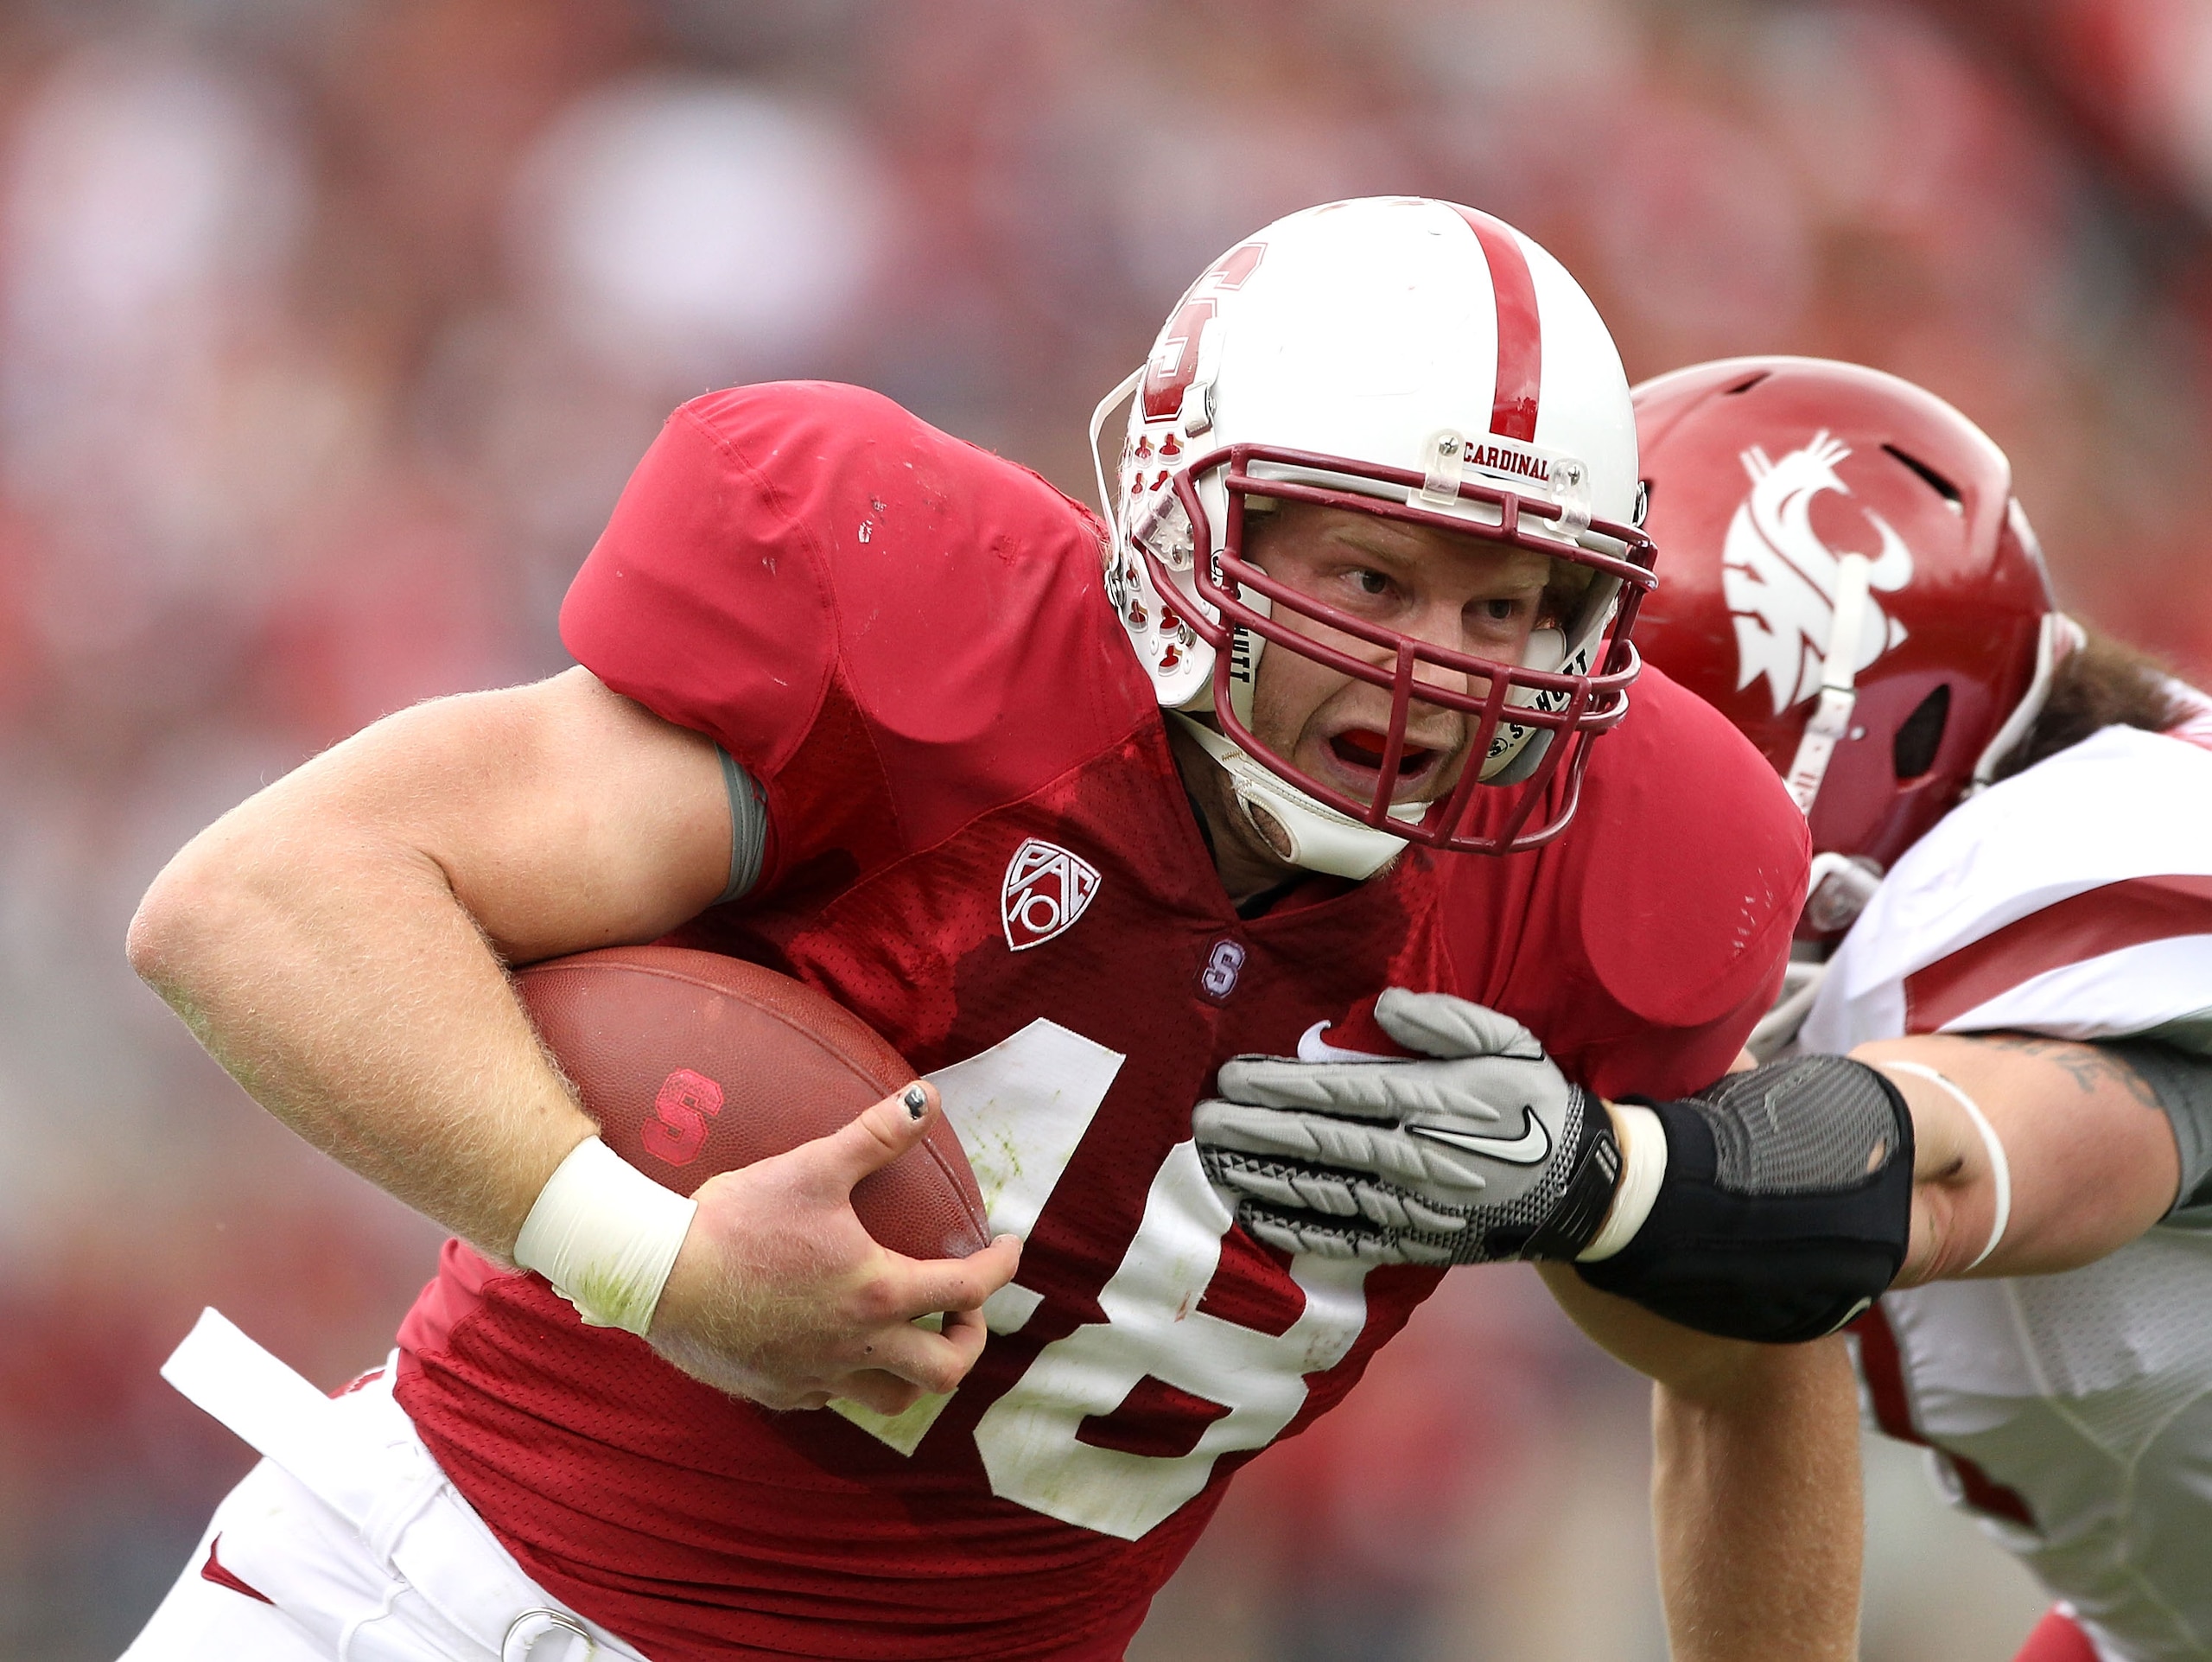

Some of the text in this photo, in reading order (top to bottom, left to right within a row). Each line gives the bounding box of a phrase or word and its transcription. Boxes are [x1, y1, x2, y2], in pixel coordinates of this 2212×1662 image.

[1463, 442, 1550, 481] CARDINAL
[1007, 844, 1096, 927] PAC
[1007, 888, 1061, 934] 10
[1201, 939, 1246, 1000] S
[640, 1067, 725, 1167] S
[826, 1016, 1368, 1543] 18
